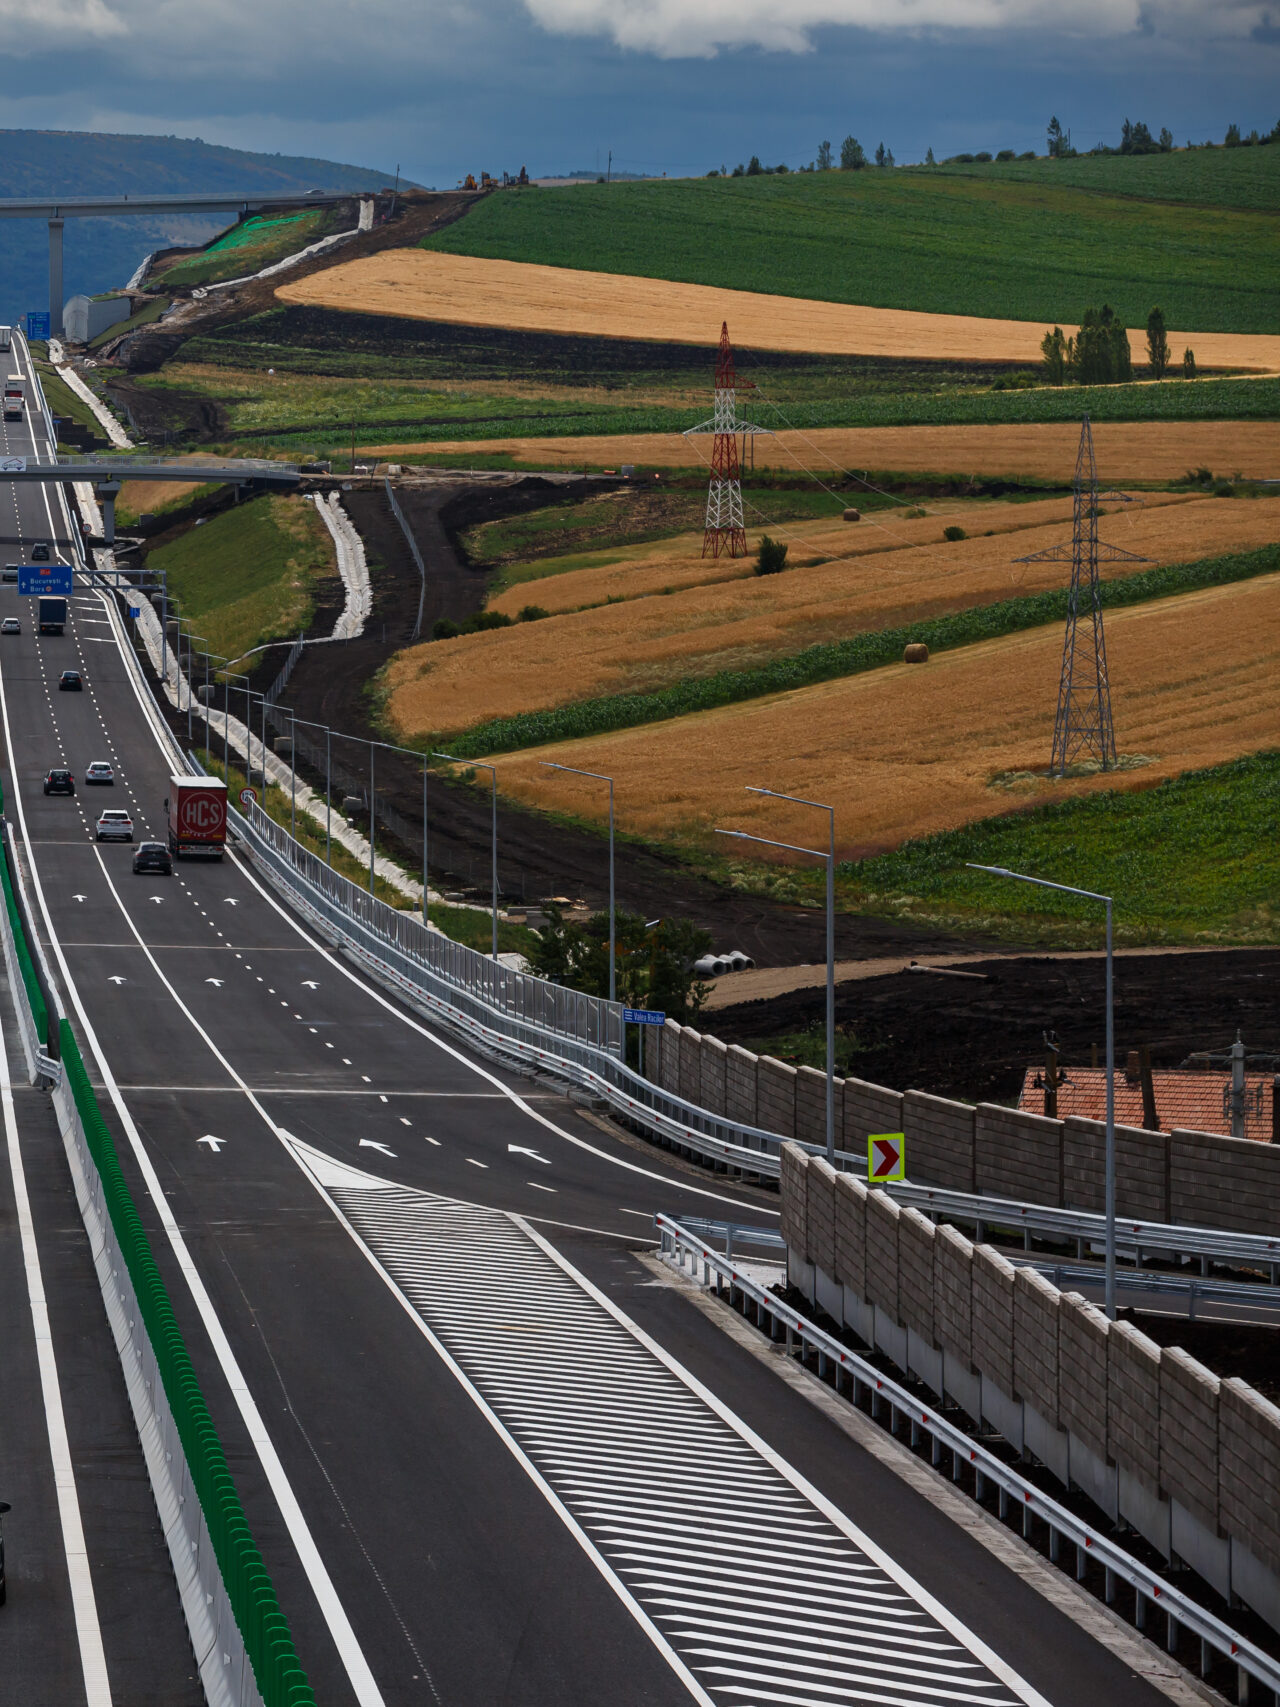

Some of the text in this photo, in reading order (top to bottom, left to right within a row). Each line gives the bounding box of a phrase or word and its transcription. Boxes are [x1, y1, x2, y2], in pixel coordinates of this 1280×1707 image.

[186, 800, 219, 827] HCS
[633, 1011, 664, 1023] Valea Racilor
